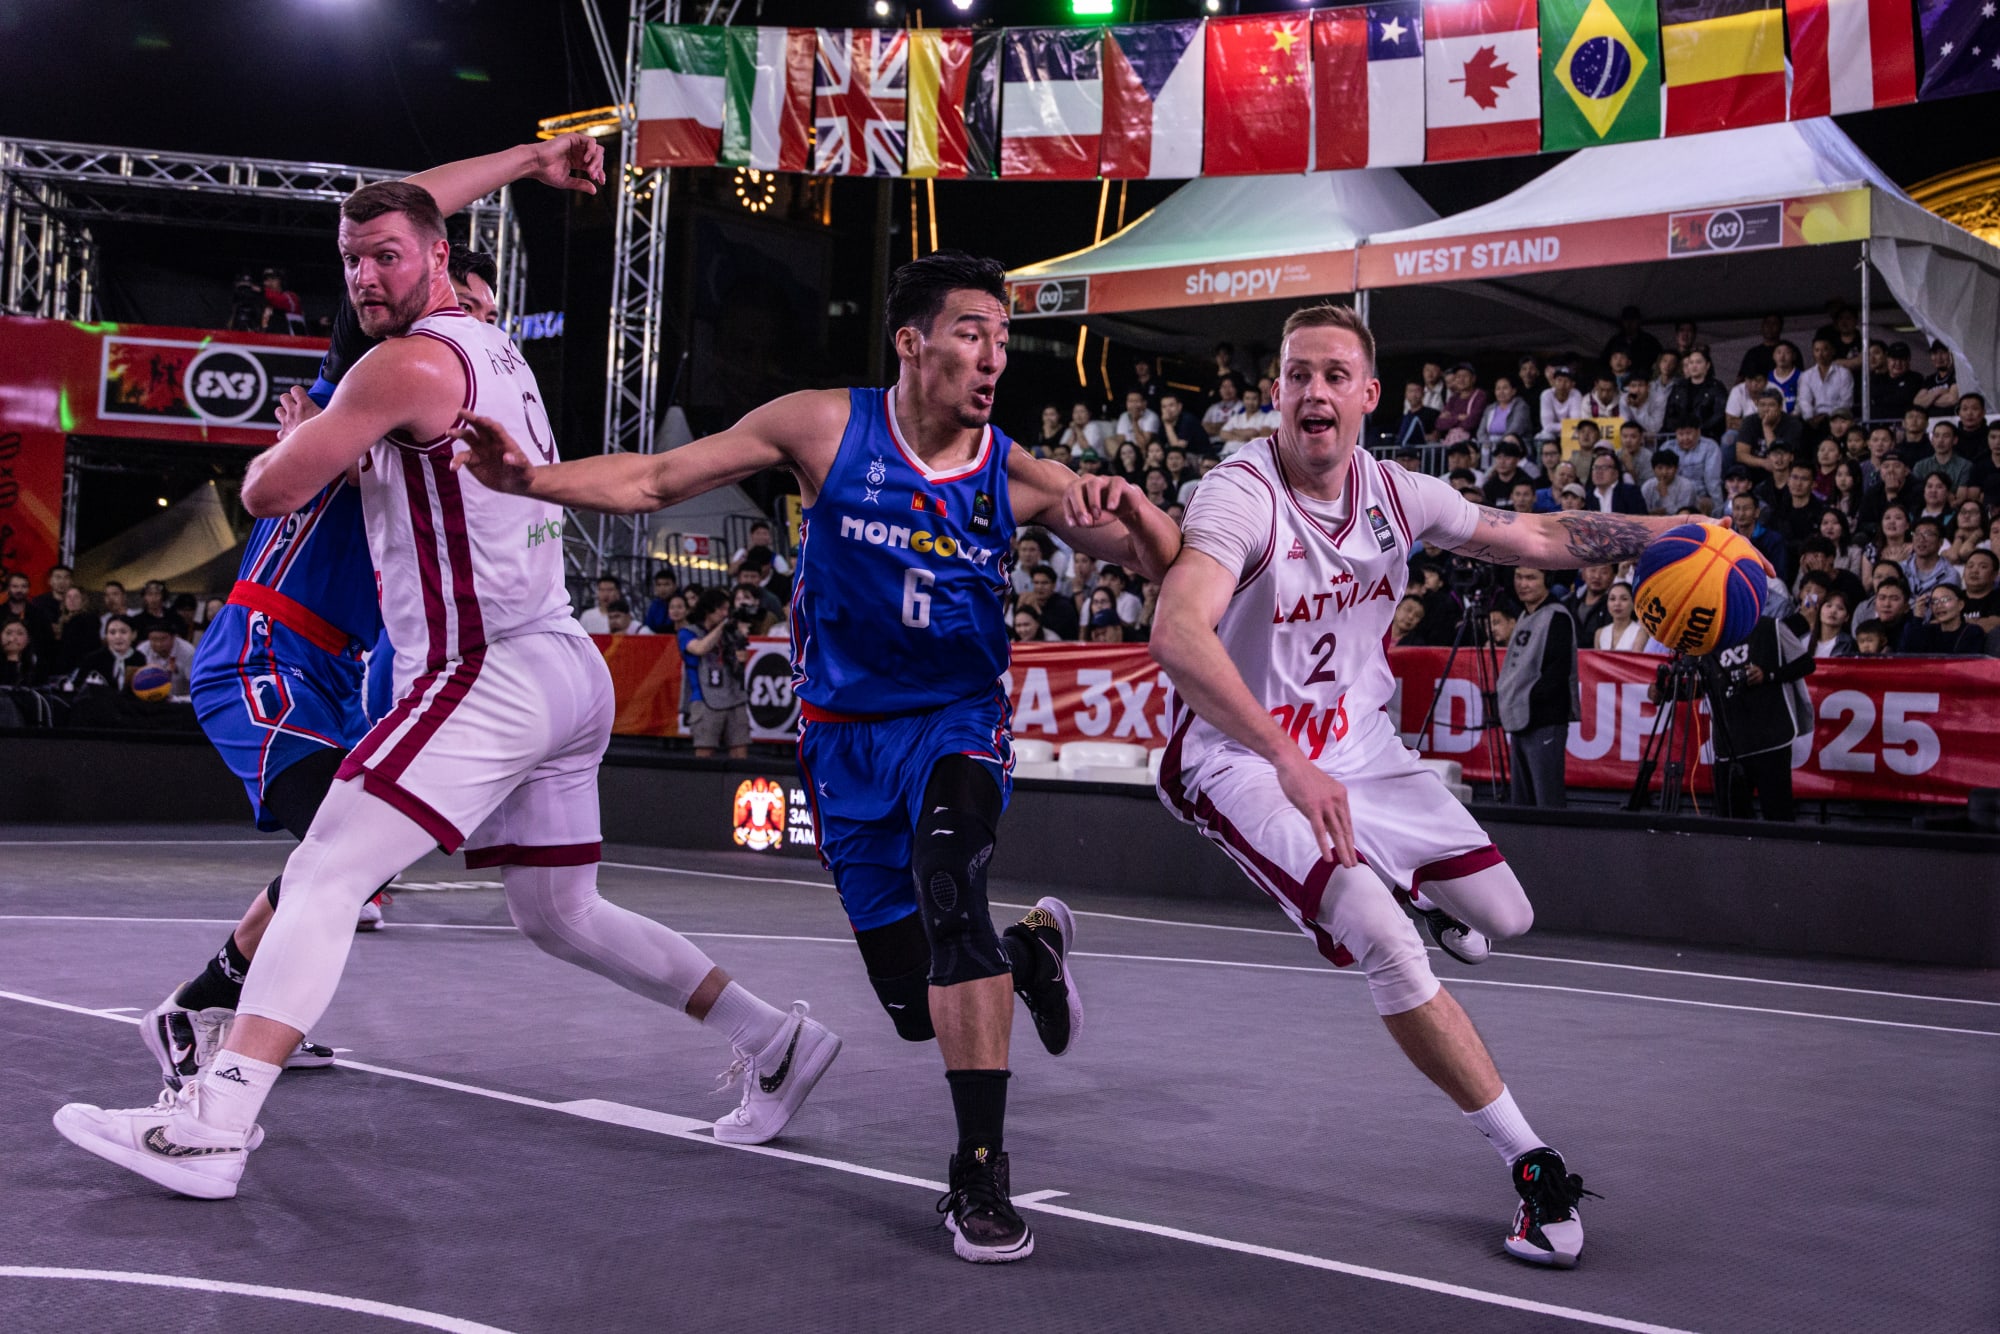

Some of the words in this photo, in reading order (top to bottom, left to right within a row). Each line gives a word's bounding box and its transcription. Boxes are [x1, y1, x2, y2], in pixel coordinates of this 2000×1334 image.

[1393, 246, 1466, 277] WEST
[1471, 236, 1560, 269] STAND
[1185, 267, 1281, 298] shoppy
[974, 515, 989, 527] FIBA
[902, 567, 936, 629] 6
[1674, 605, 1717, 655] Wil
[1304, 632, 1337, 687] 2
[1508, 682, 1673, 762] UP
[1699, 689, 1941, 776] 25
